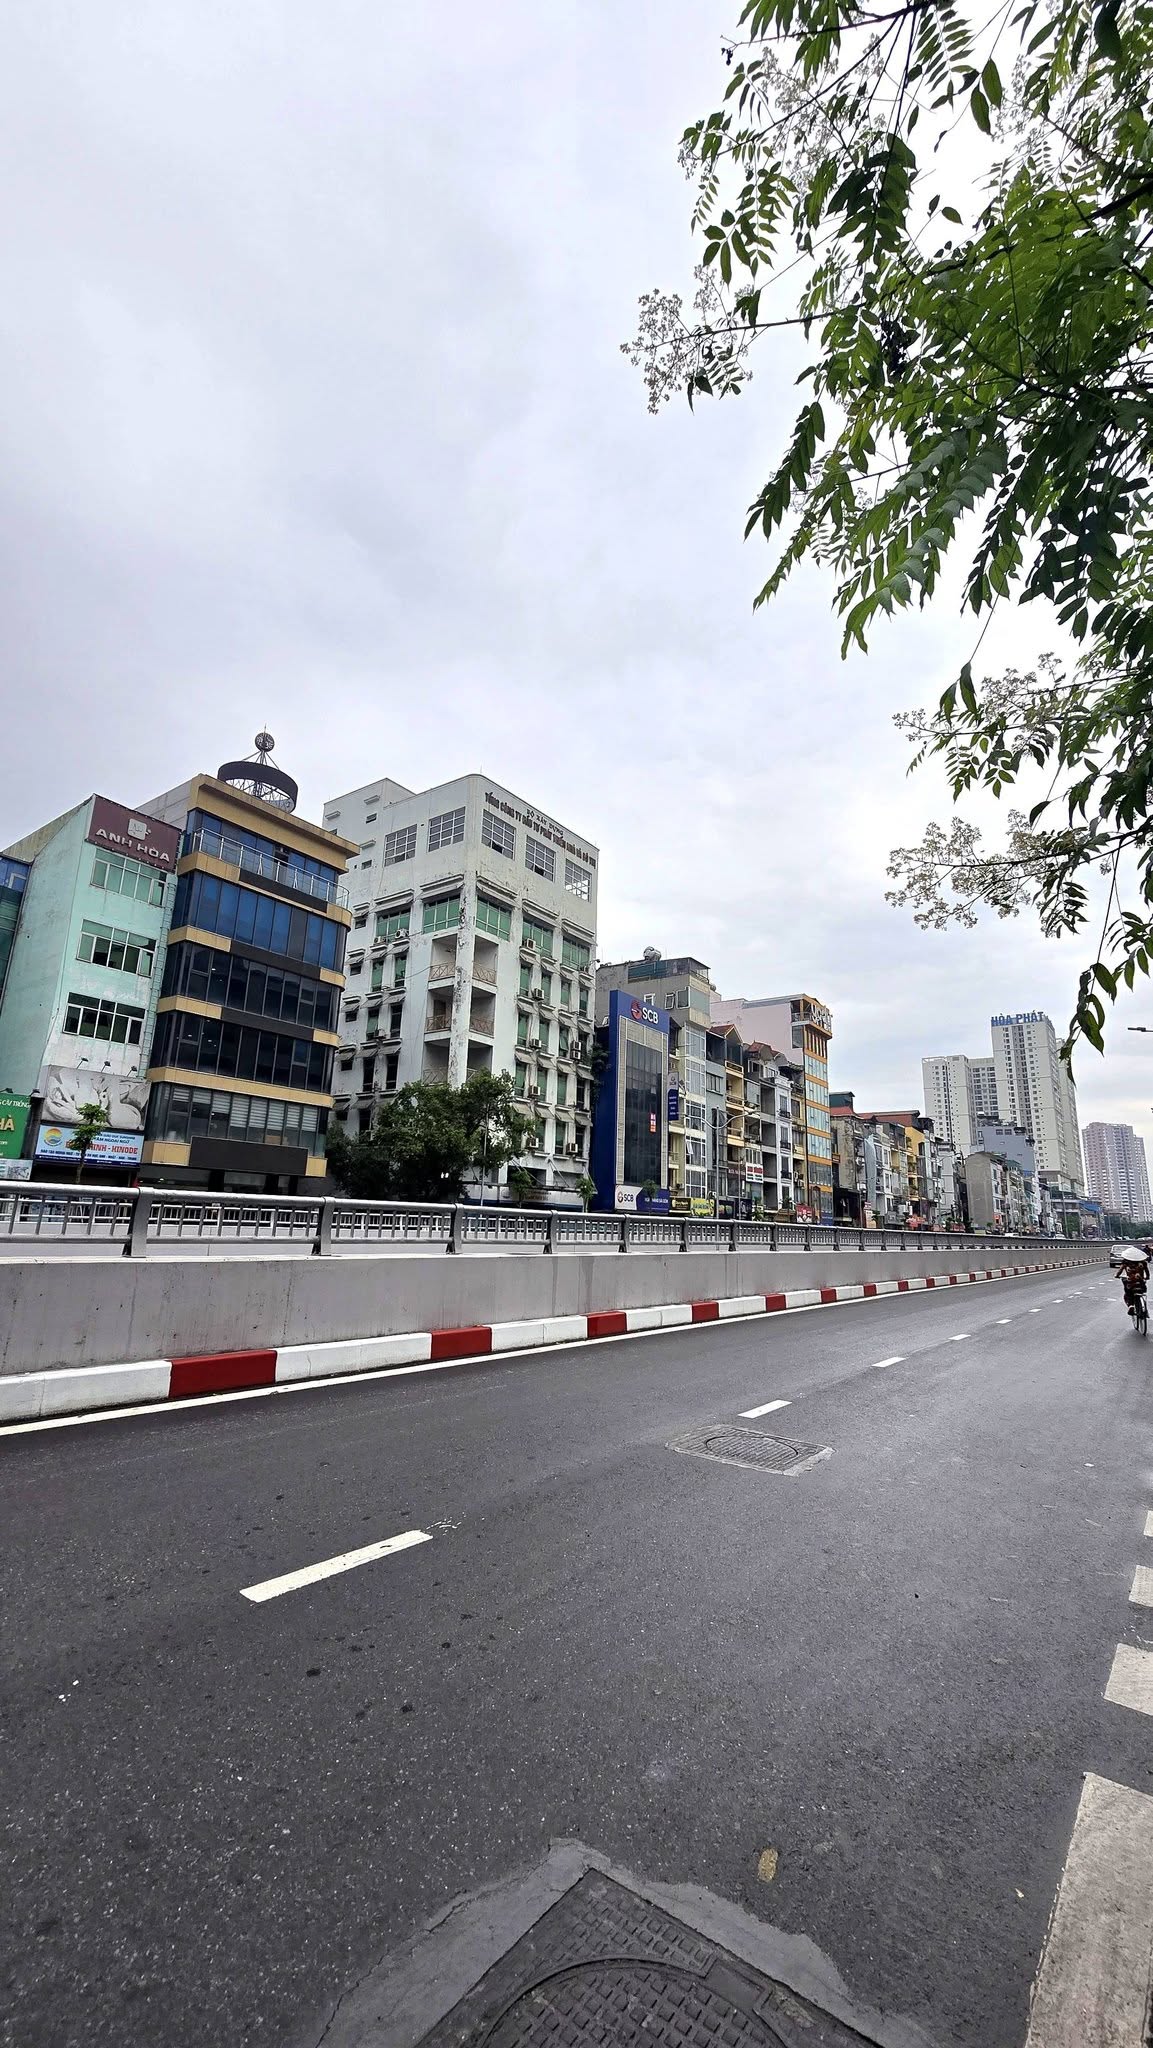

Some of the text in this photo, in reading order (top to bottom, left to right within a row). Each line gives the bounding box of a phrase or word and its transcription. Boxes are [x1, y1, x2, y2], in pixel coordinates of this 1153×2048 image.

[96, 828, 170, 862] ANH HÒA
[642, 1007, 658, 1024] SCB
[991, 1010, 1044, 1026] HÒA PHÁT
[112, 1146, 138, 1154] HINODE
[624, 1194, 634, 1202] SCB
